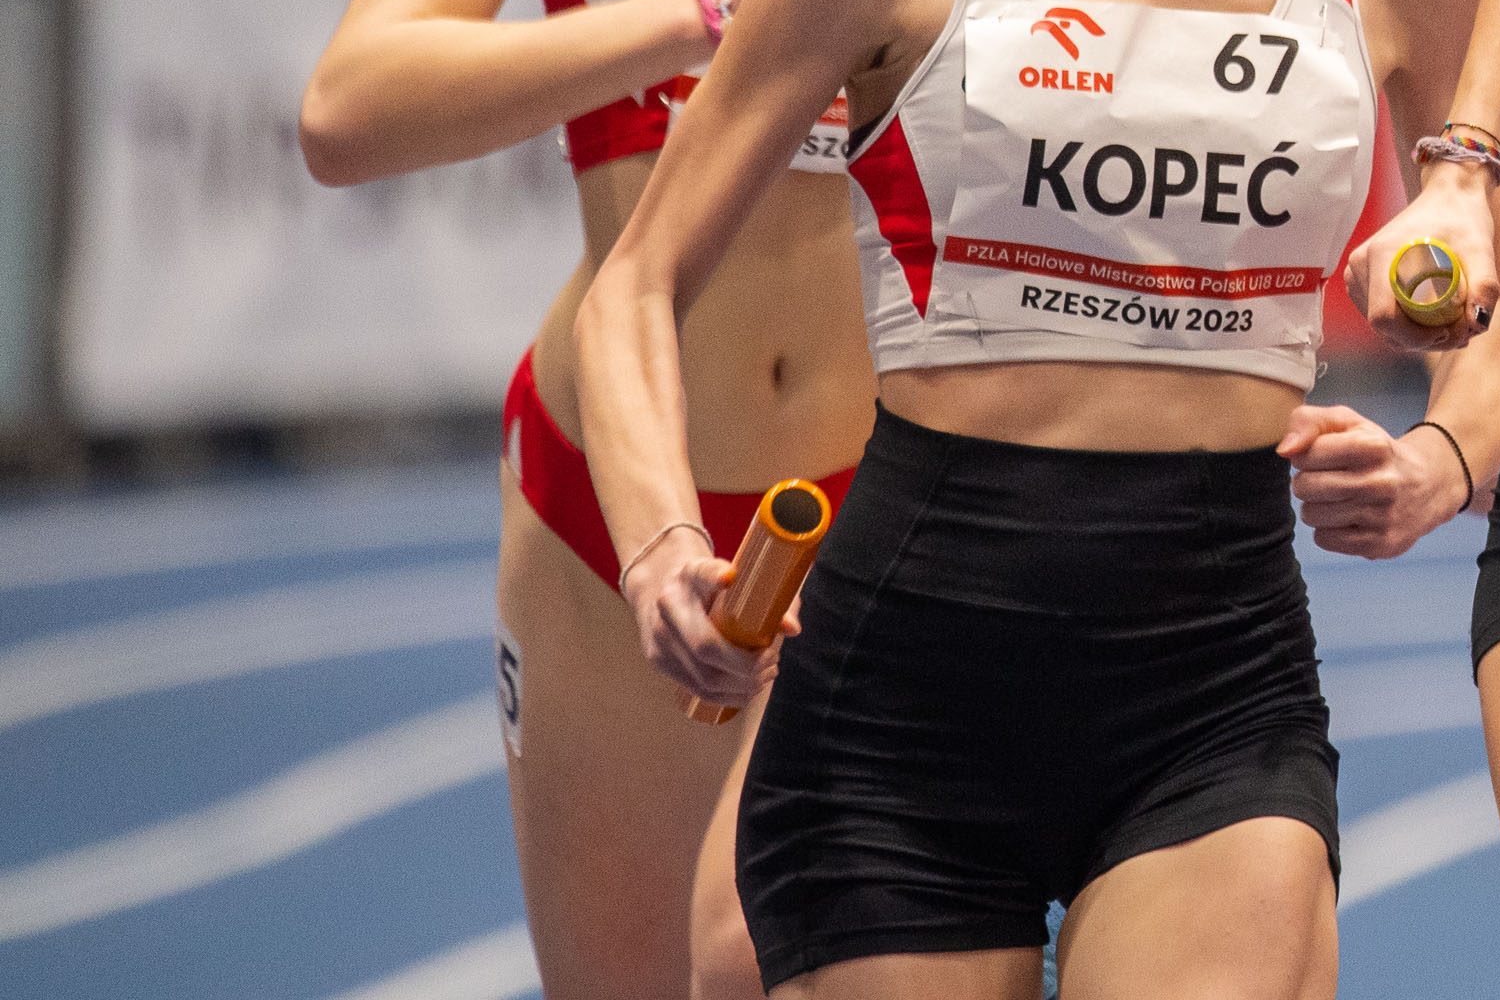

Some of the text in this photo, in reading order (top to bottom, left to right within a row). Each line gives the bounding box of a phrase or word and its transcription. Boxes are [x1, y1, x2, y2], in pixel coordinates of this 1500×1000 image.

[1018, 66, 1113, 94] ORLEN
[1213, 33, 1299, 95] 67
[1021, 137, 1300, 228] KOPEĆ
[966, 245, 1305, 294] PZLA Halowe Mistrzostwa Polski U18 U20
[1020, 285, 1254, 333] RZESZÓW 2023
